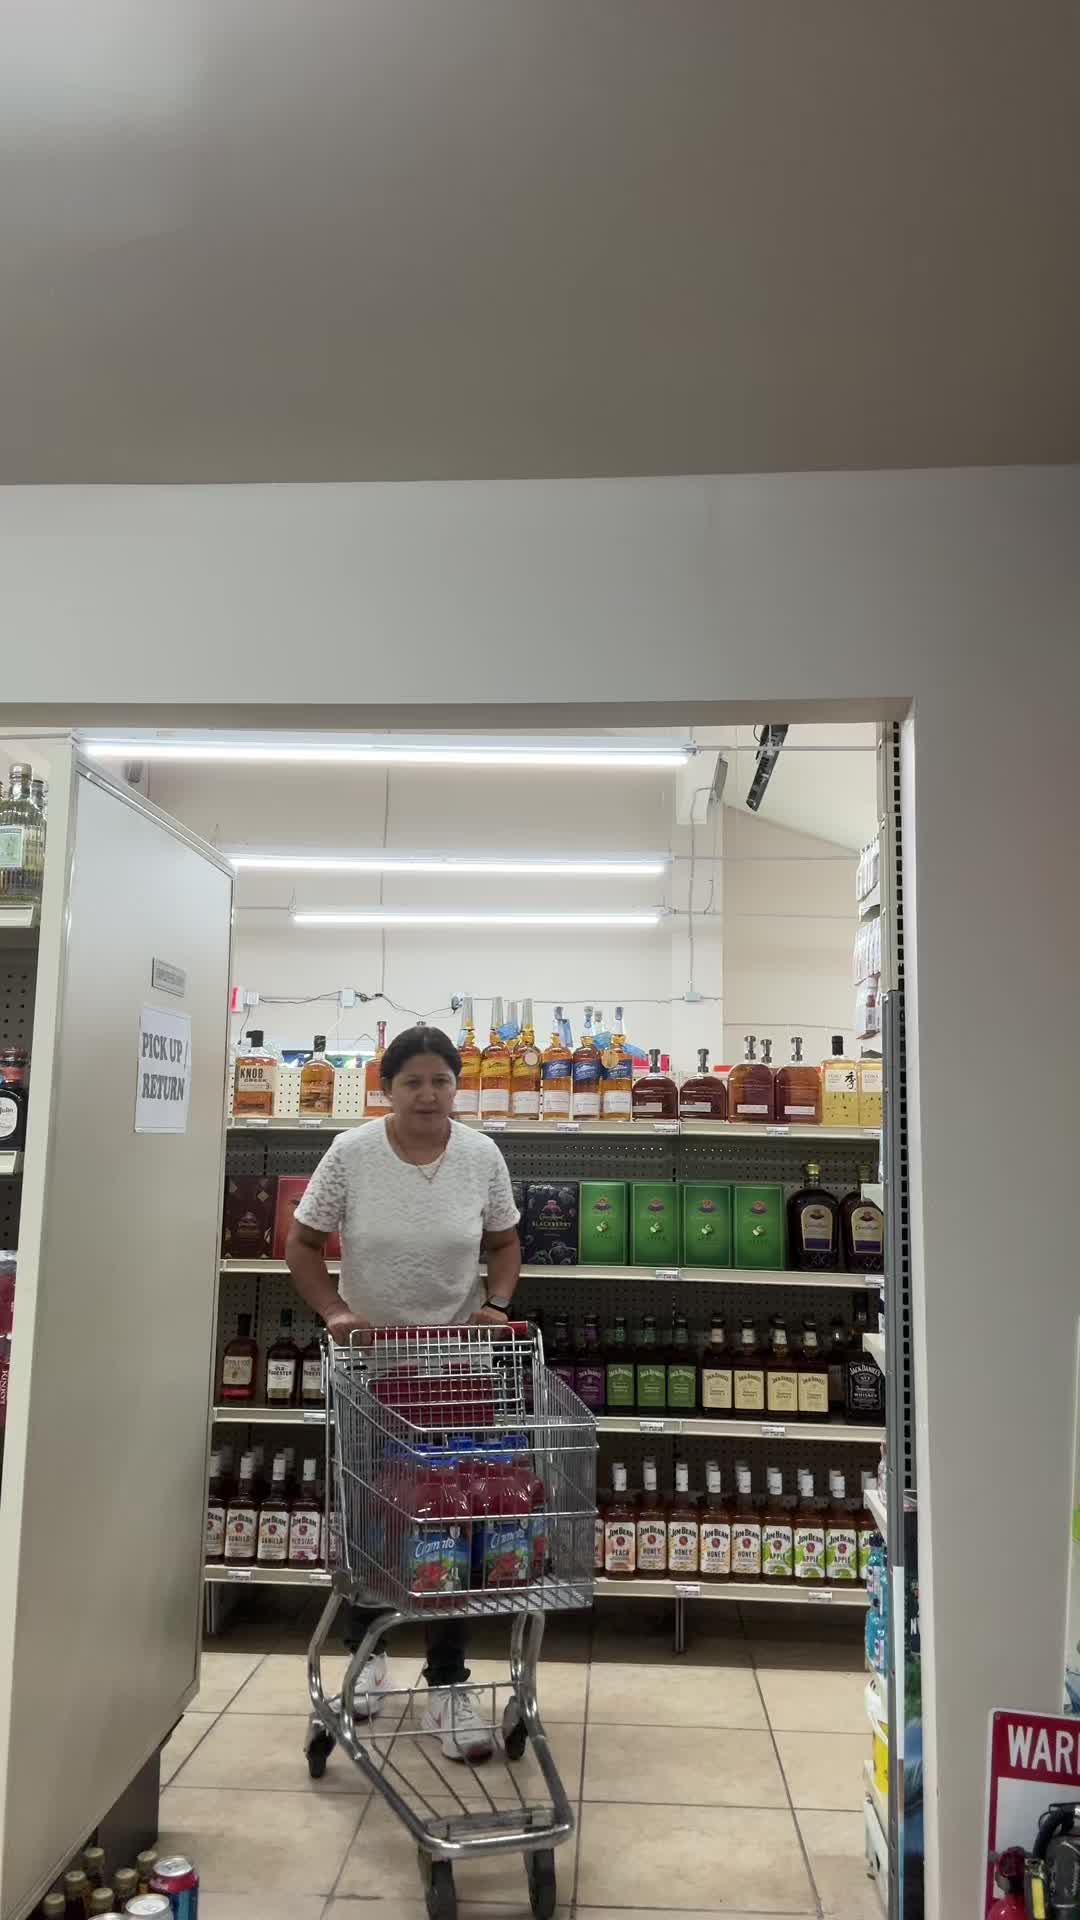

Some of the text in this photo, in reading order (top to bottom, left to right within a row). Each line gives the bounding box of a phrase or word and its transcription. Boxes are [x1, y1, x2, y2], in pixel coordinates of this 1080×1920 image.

[142, 1032, 168, 1062] PICK
[169, 1039, 182, 1063] UP
[240, 1068, 264, 1079] KNOB
[142, 1073, 185, 1101] RETURN
[849, 1366, 862, 1376] JACK
[609, 1529, 618, 1539] JIM
[618, 1527, 634, 1538] BEAM
[641, 1526, 665, 1537] JIM BEAM
[671, 1527, 697, 1539] JIM BEAM
[704, 1528, 729, 1540] JIM BEAM
[736, 1529, 760, 1540] JIM BEAM
[766, 1531, 791, 1543] JIM BEAM
[798, 1533, 823, 1545] JIM BEAM
[831, 1534, 855, 1546] JIM BEAM
[611, 1549, 630, 1557] PEACH
[642, 1547, 661, 1555] HONEY
[674, 1548, 692, 1556] HONEY
[1008, 1724, 1080, 1775] WAR
